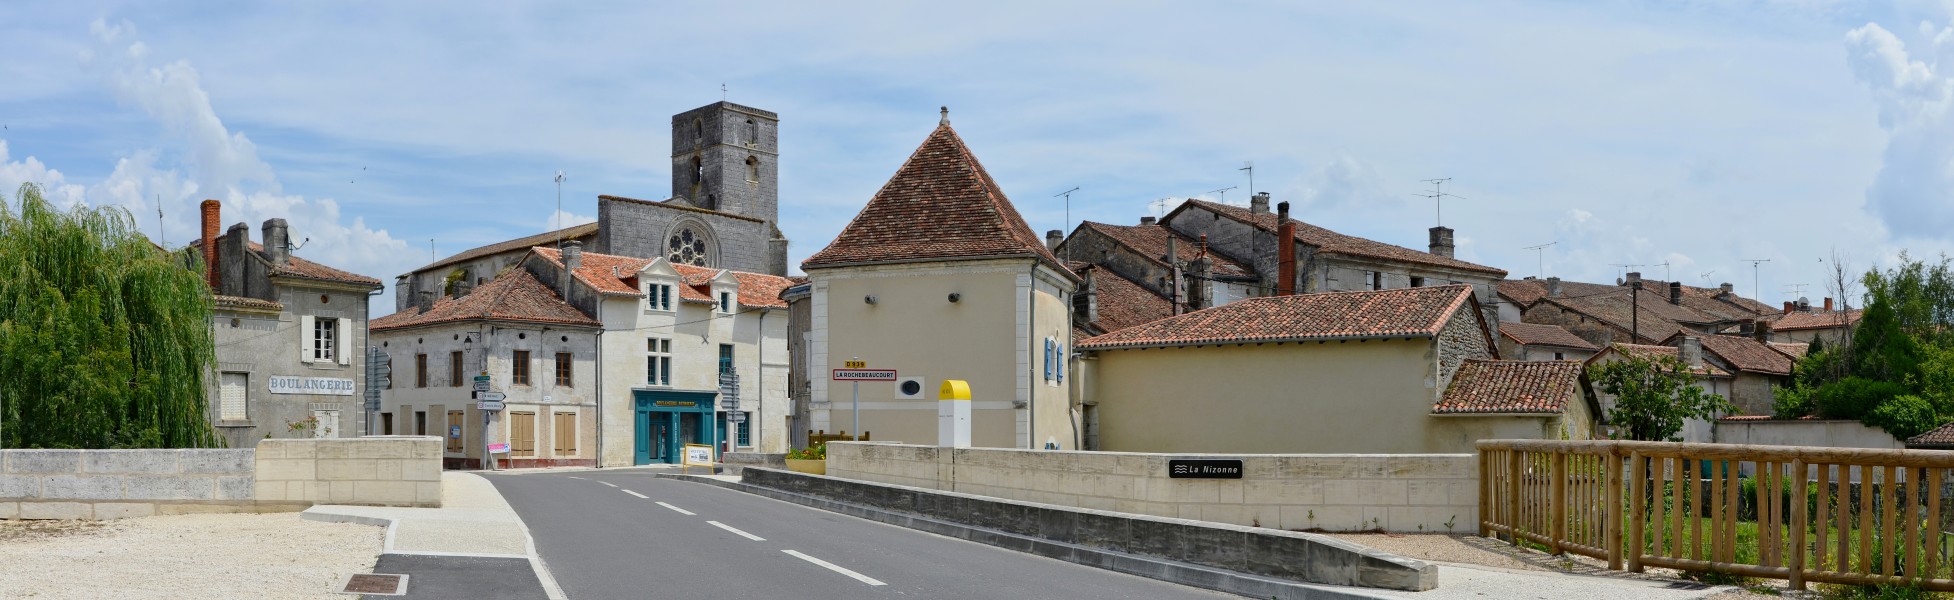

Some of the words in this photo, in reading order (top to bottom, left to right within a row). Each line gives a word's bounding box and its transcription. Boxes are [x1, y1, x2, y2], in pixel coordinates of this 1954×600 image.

[270, 377, 353, 391] BOULANGERIE
[1189, 465, 1199, 473] La
[1203, 465, 1238, 474] Nizonne
